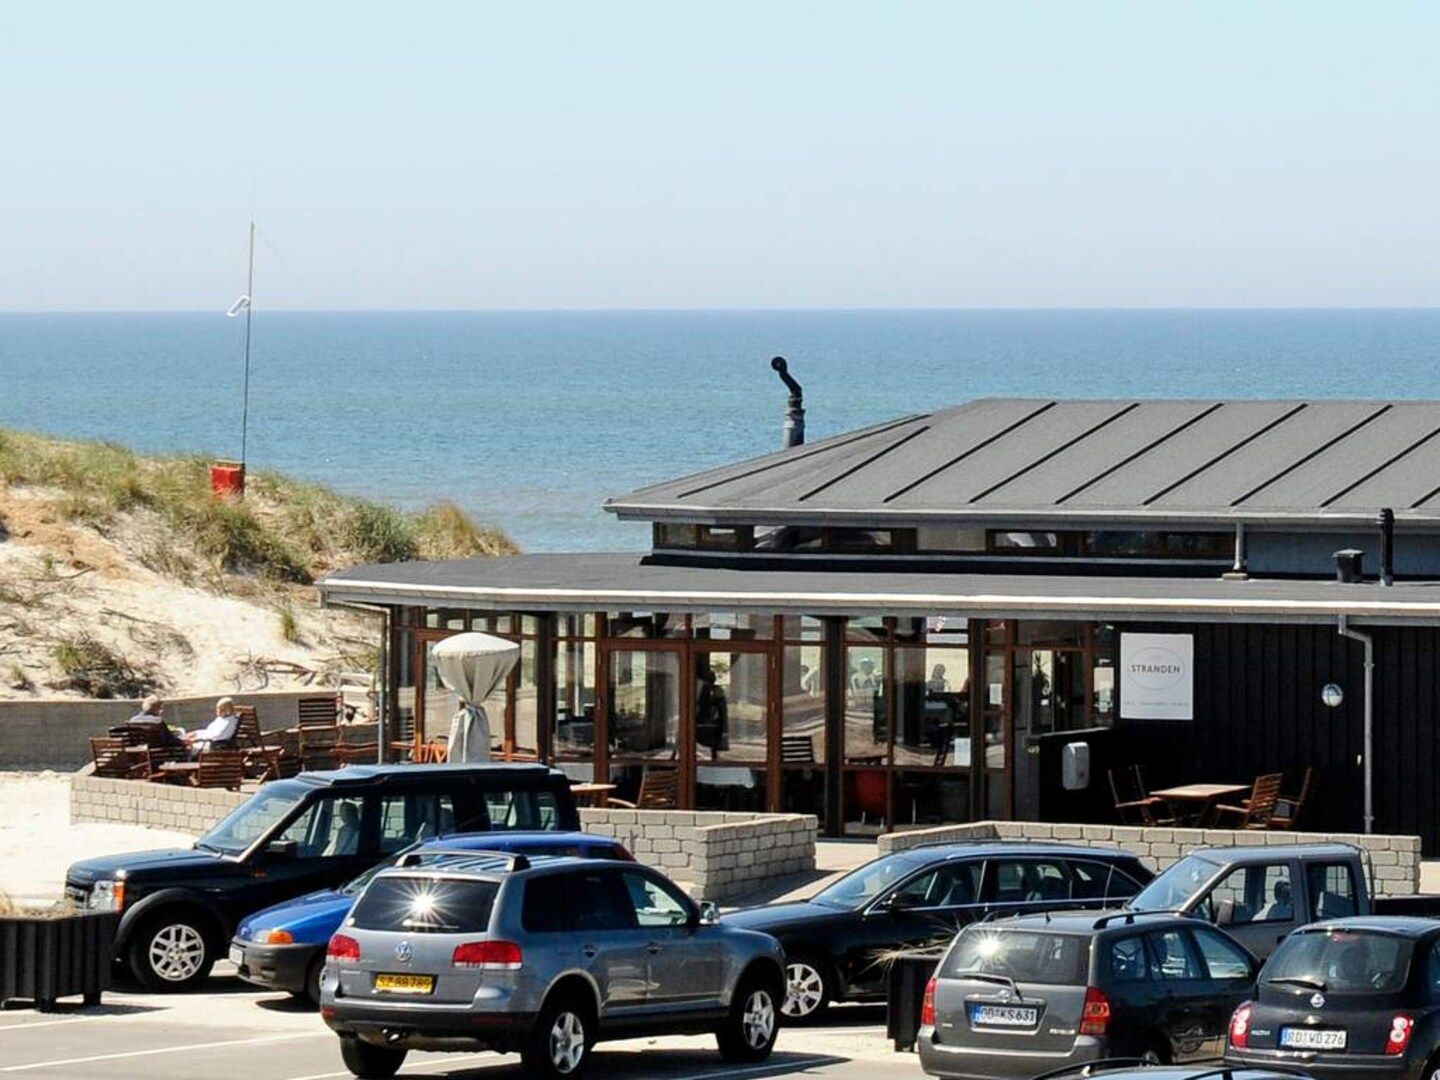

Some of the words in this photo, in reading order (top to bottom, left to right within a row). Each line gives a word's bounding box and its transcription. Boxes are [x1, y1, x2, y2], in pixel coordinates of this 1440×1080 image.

[1131, 665, 1181, 673] STRANDEN
[1016, 1008, 1035, 1021] 631
[1324, 1033, 1344, 1045] 276
